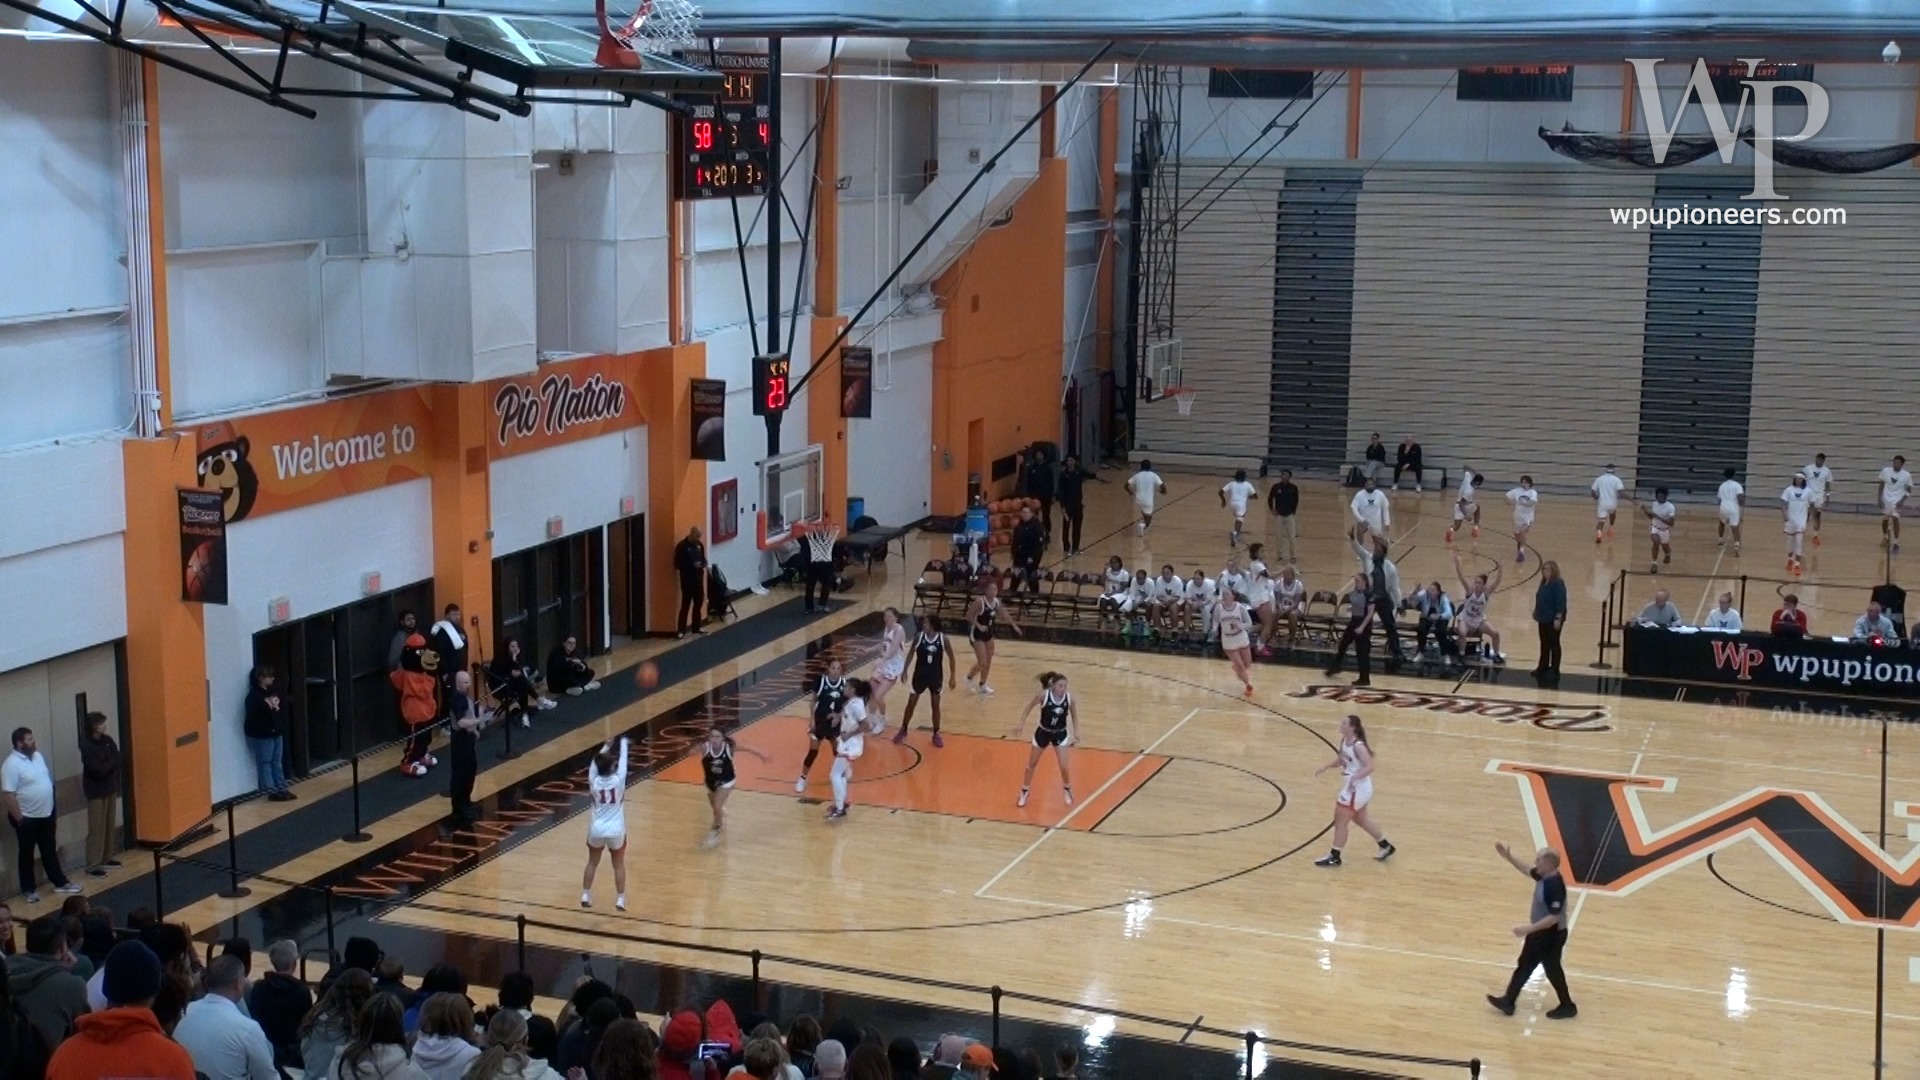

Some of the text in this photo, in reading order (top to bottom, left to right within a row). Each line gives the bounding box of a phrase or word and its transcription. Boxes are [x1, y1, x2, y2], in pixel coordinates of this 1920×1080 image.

[693, 122, 712, 148] 58
[494, 373, 625, 446] Pio Nation
[272, 423, 415, 480] Welcome to
[1711, 640, 1765, 680] WP
[1772, 653, 1920, 686] wpupion
[599, 787, 617, 804] 11
